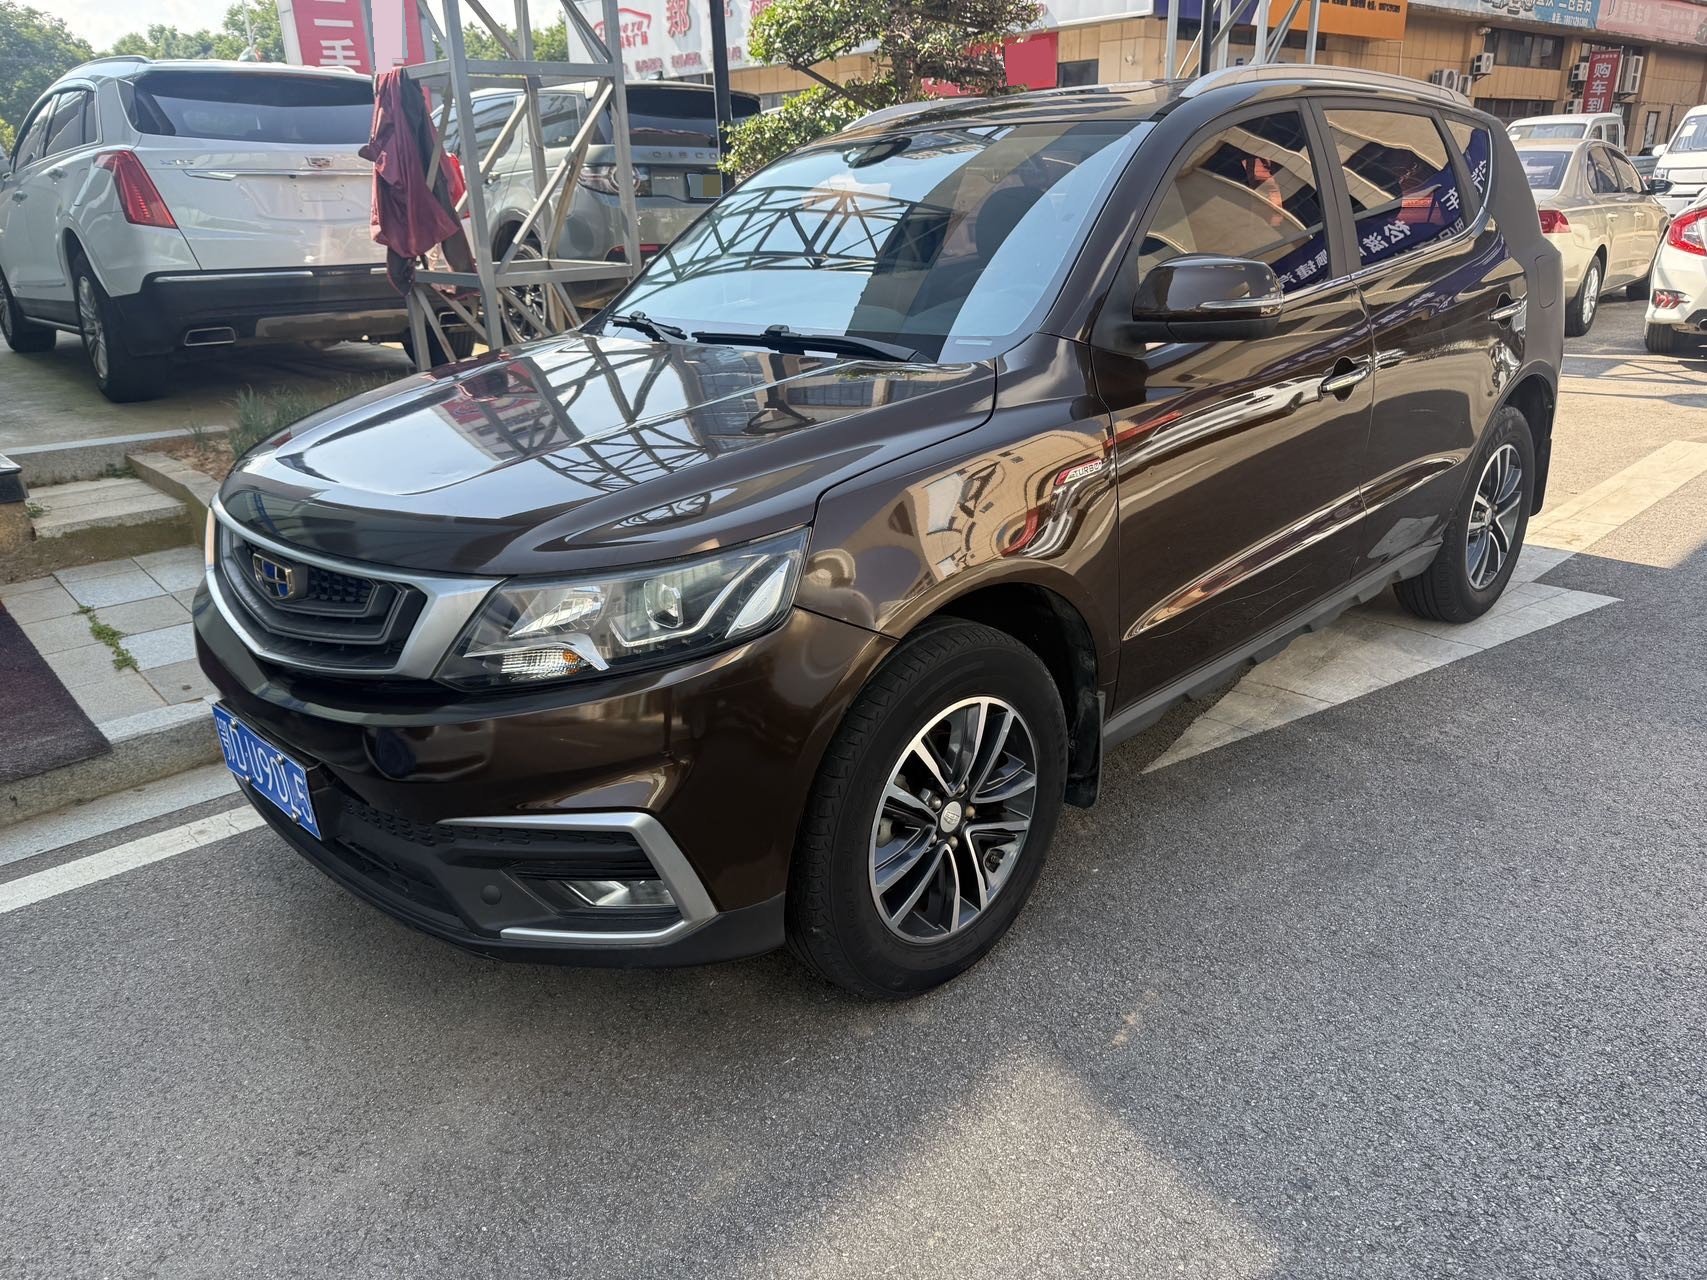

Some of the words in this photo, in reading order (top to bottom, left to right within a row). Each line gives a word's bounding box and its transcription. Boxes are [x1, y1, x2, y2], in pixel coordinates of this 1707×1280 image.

[1586, 63, 1612, 112] 购车到
[1072, 463, 1100, 478] TURBO
